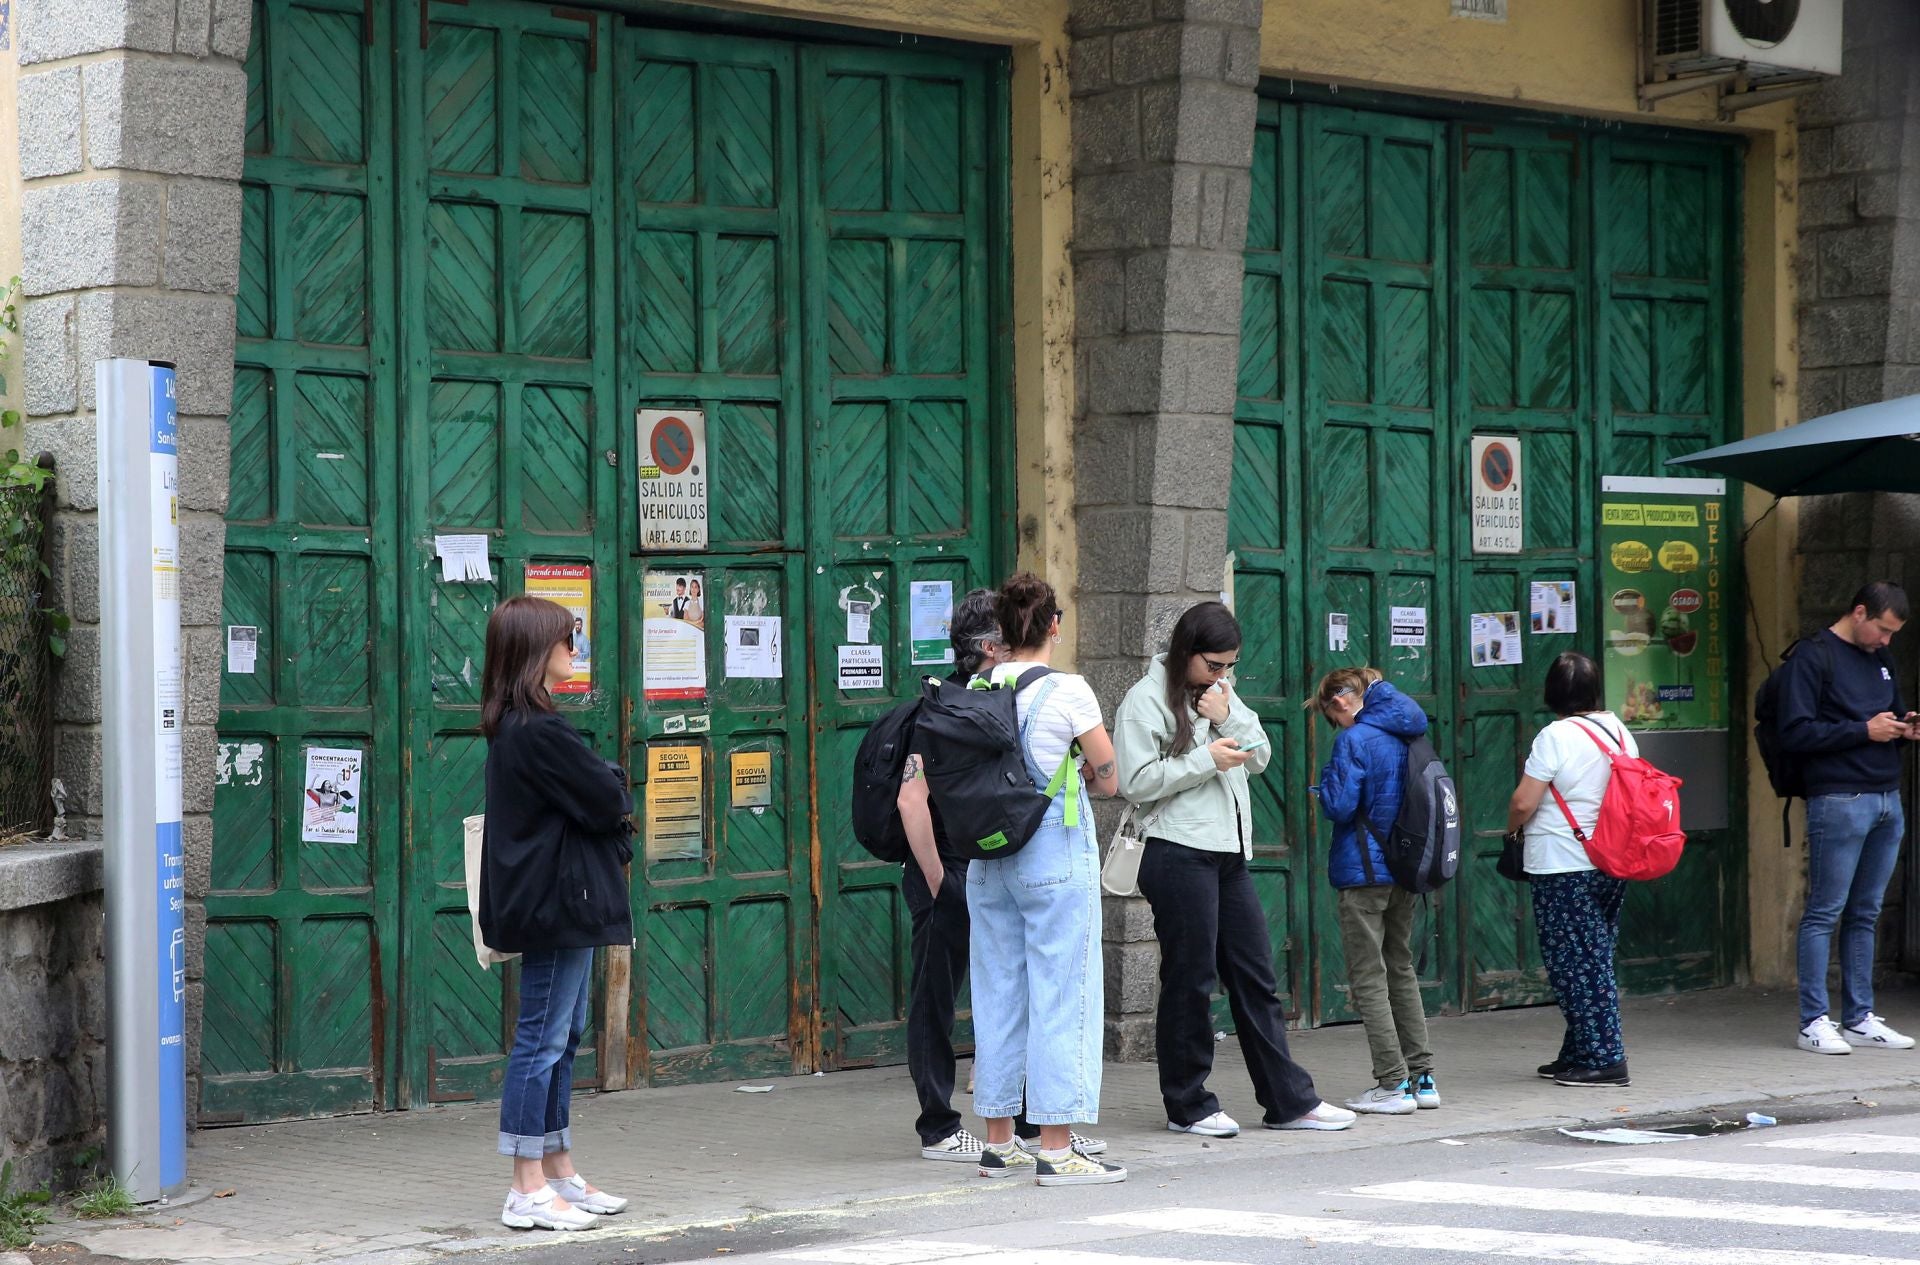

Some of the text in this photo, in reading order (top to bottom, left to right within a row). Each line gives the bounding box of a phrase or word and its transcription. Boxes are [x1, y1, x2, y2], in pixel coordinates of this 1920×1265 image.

[642, 482, 704, 498] SALIDA DE
[1475, 496, 1520, 511] SALIDA DE
[641, 503, 706, 520] VEHICULOS
[1475, 514, 1520, 529] VEHICULOS
[669, 529, 682, 544] 45
[1659, 686, 1694, 700] vegafrut
[310, 754, 358, 763] CONCENTRACIÓN
[659, 753, 689, 761] SEGOVIA
[736, 767, 766, 776] SEGOVIA
